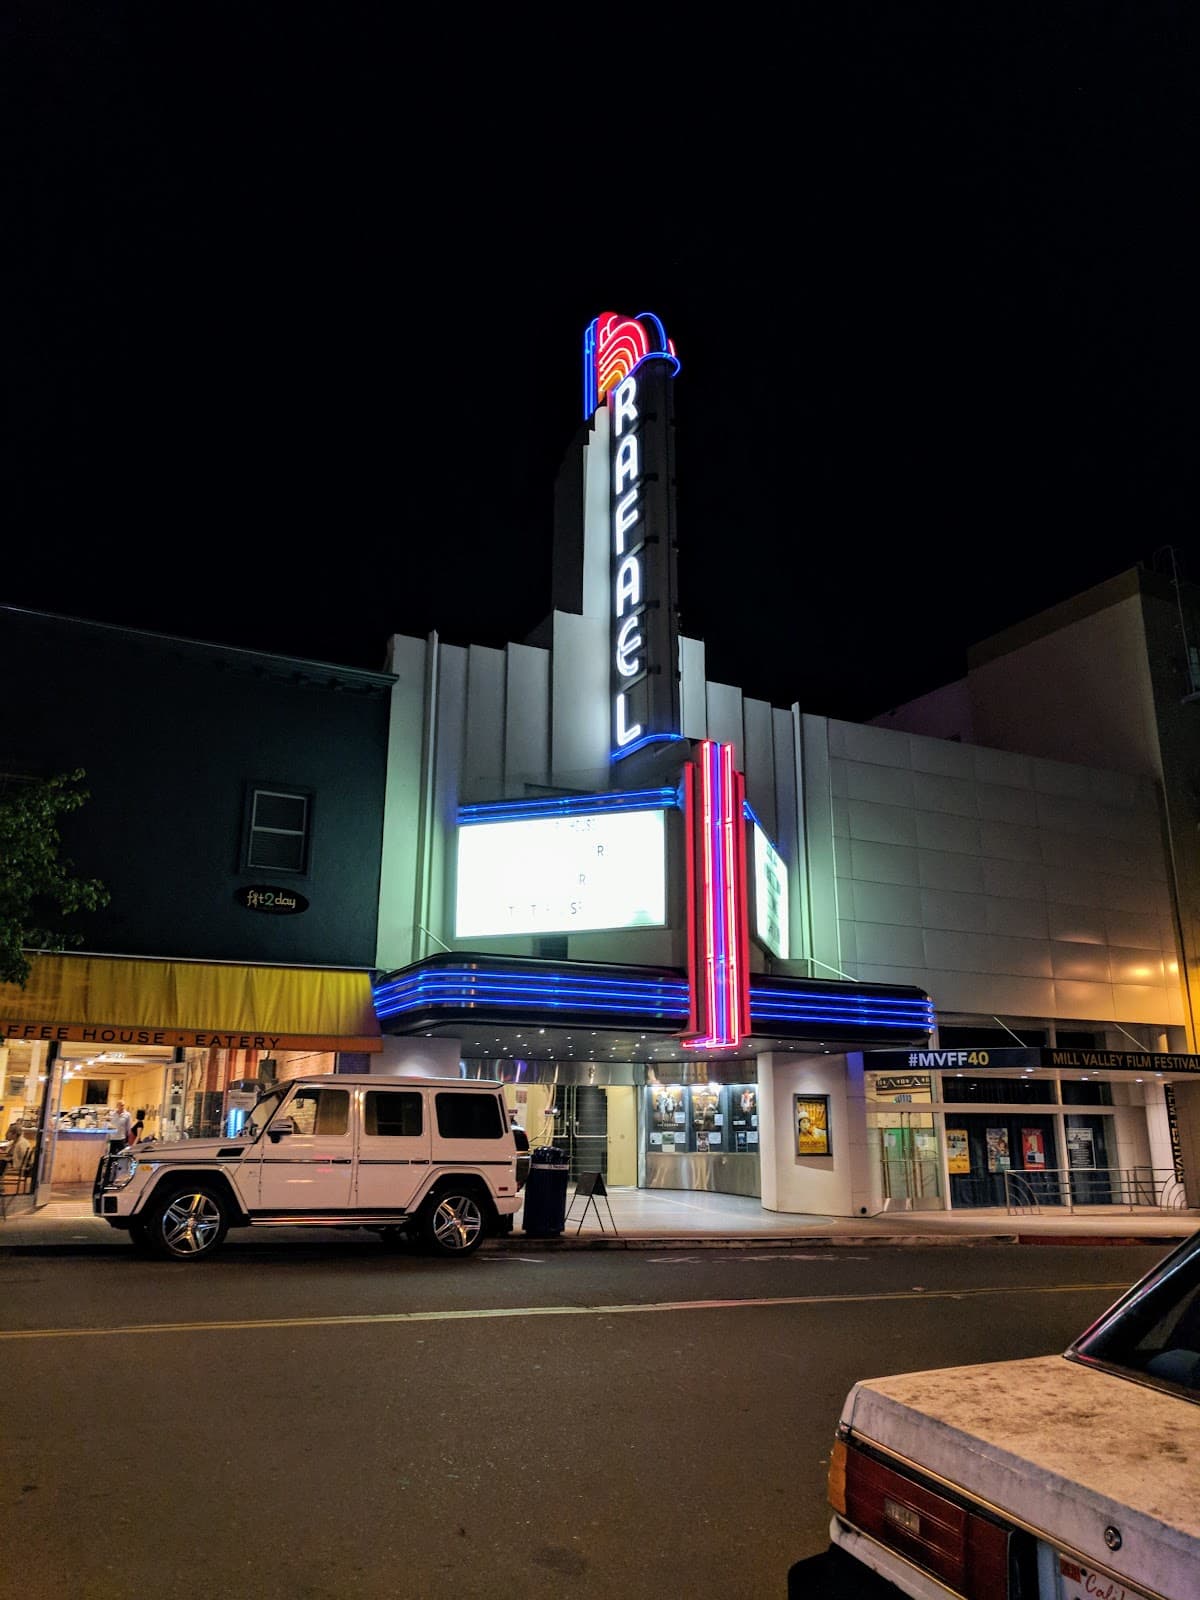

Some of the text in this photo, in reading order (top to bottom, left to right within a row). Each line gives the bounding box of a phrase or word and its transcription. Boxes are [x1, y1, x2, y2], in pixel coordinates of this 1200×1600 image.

[614, 376, 641, 747] RAFAEL
[82, 1028, 165, 1045] HOUSE
[194, 1034, 281, 1049] EATERY
[908, 1051, 990, 1067] #MVFF40
[1052, 1052, 1200, 1070] MILL VALLEY FILM FESTIVAL
